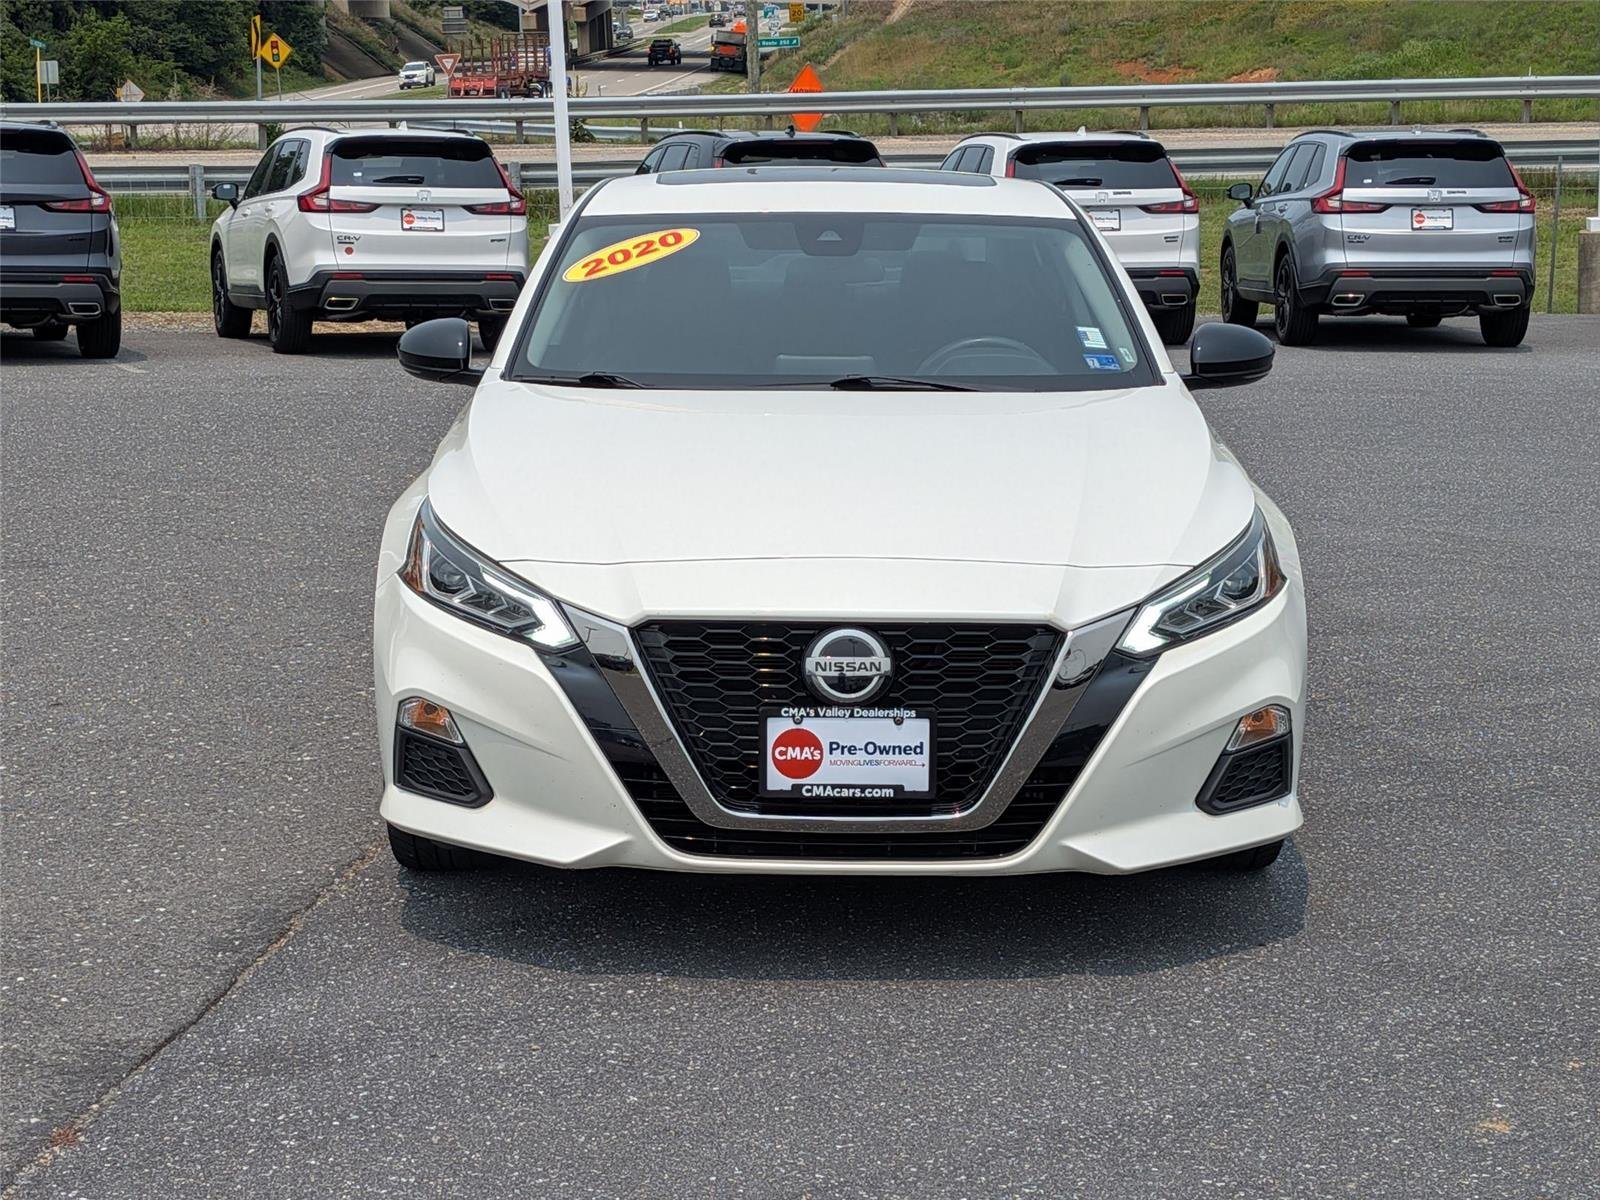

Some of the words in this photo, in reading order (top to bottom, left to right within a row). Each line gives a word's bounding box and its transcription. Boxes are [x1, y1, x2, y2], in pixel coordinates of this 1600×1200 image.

[581, 231, 684, 278] 2020
[815, 661, 882, 672] NISSAN
[781, 707, 815, 717] CMA's
[818, 707, 851, 719] Valley
[854, 708, 916, 719] Dealerships
[774, 746, 821, 760] CMA's
[829, 741, 924, 755] Pre-Owned
[802, 785, 894, 798] CMAcars.com
